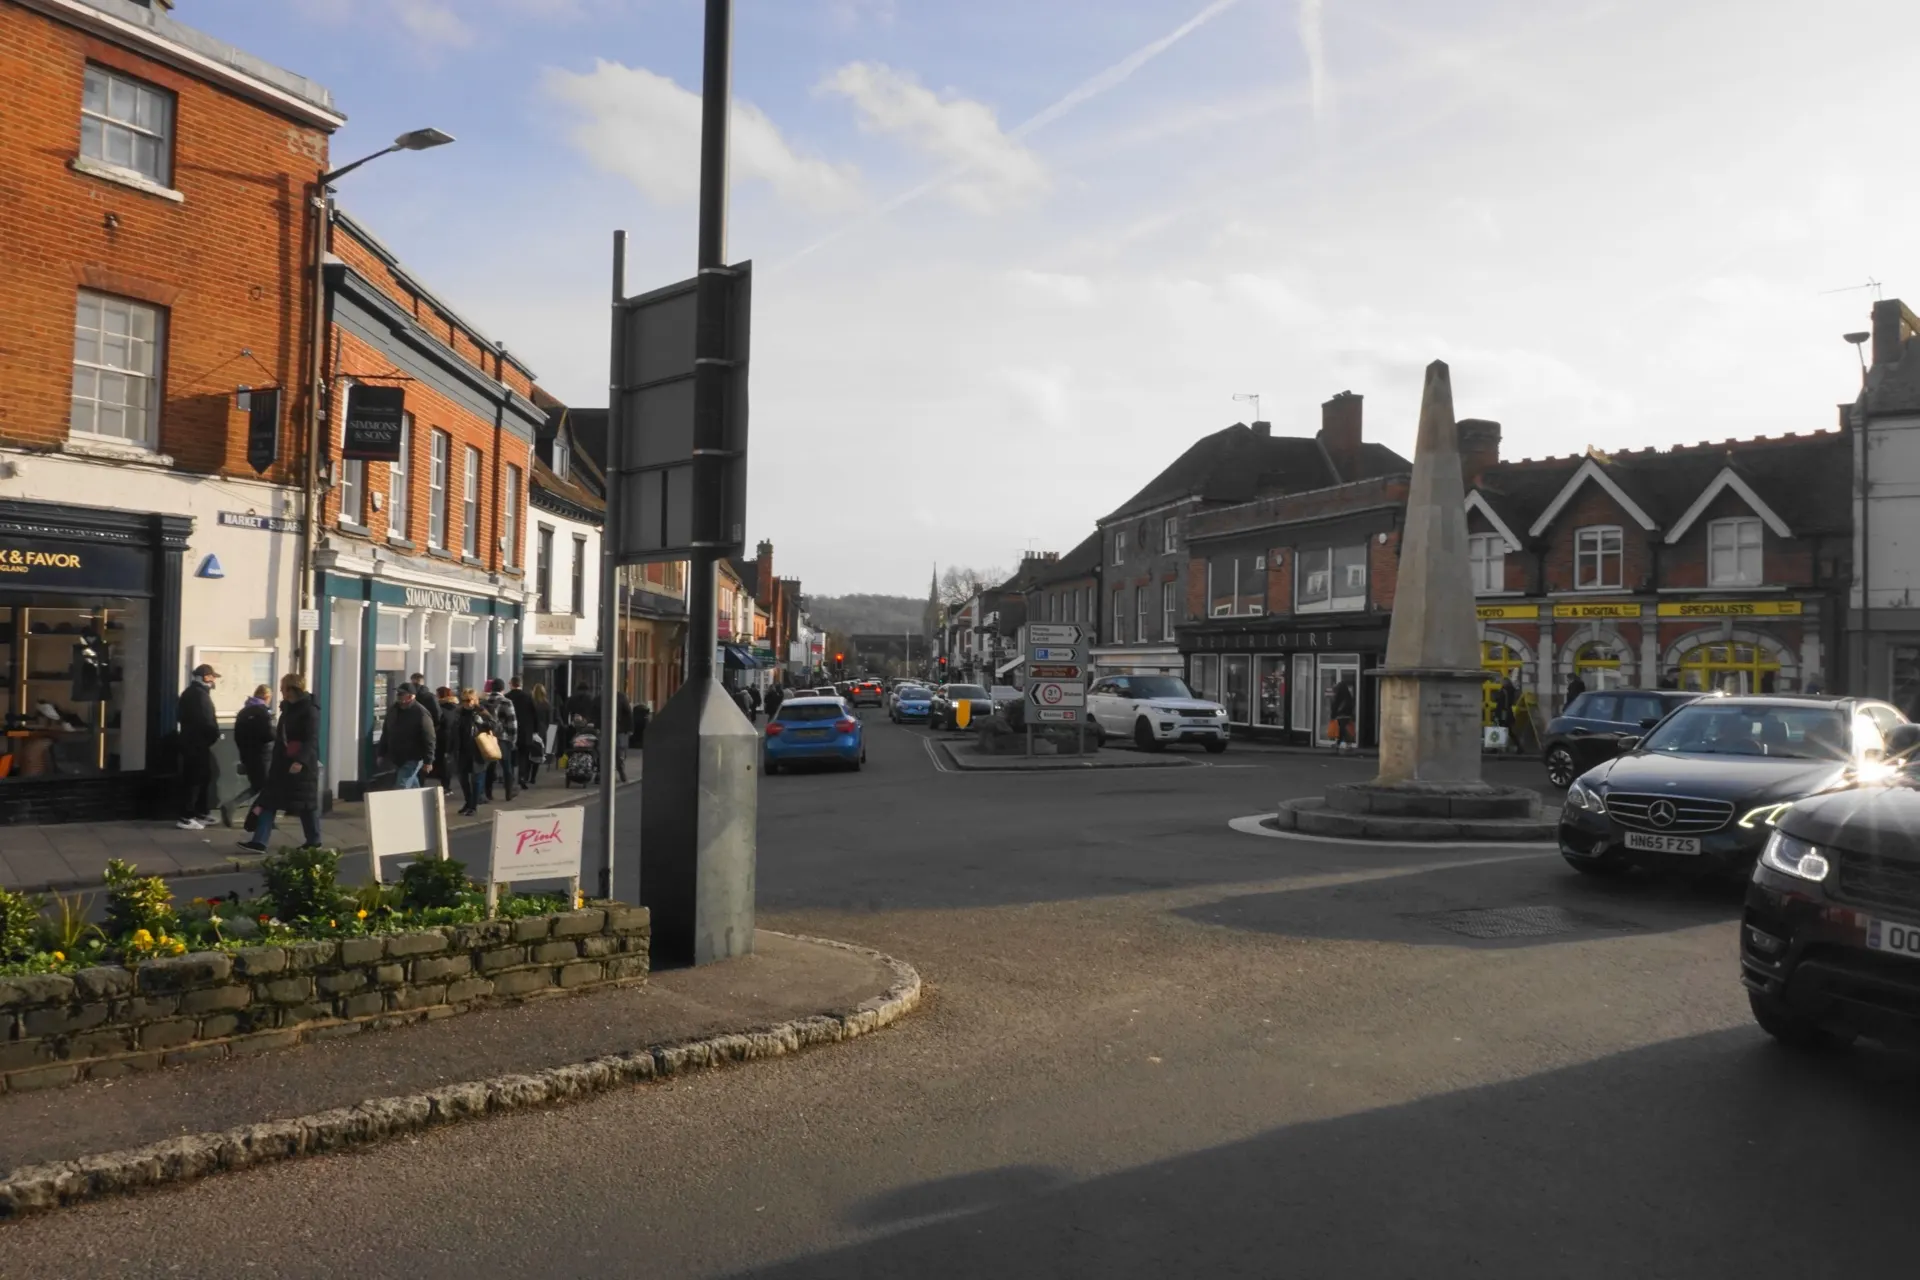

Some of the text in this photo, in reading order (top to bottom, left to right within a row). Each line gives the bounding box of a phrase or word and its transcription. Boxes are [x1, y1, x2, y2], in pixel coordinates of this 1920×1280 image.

[350, 420, 399, 431] SIMMONS
[364, 431, 392, 440] SONS
[224, 514, 263, 527] MARKET
[9, 550, 23, 564] &
[26, 551, 81, 568] FAVOR
[406, 587, 470, 613] SIMMONS & SONS
[1582, 606, 1621, 616] DIGITAL
[1680, 604, 1754, 615] SPECIALISTS
[1196, 632, 1333, 649] REPERTOIRE
[516, 820, 563, 854] Pink
[1630, 834, 1695, 851] HN65 FZS
